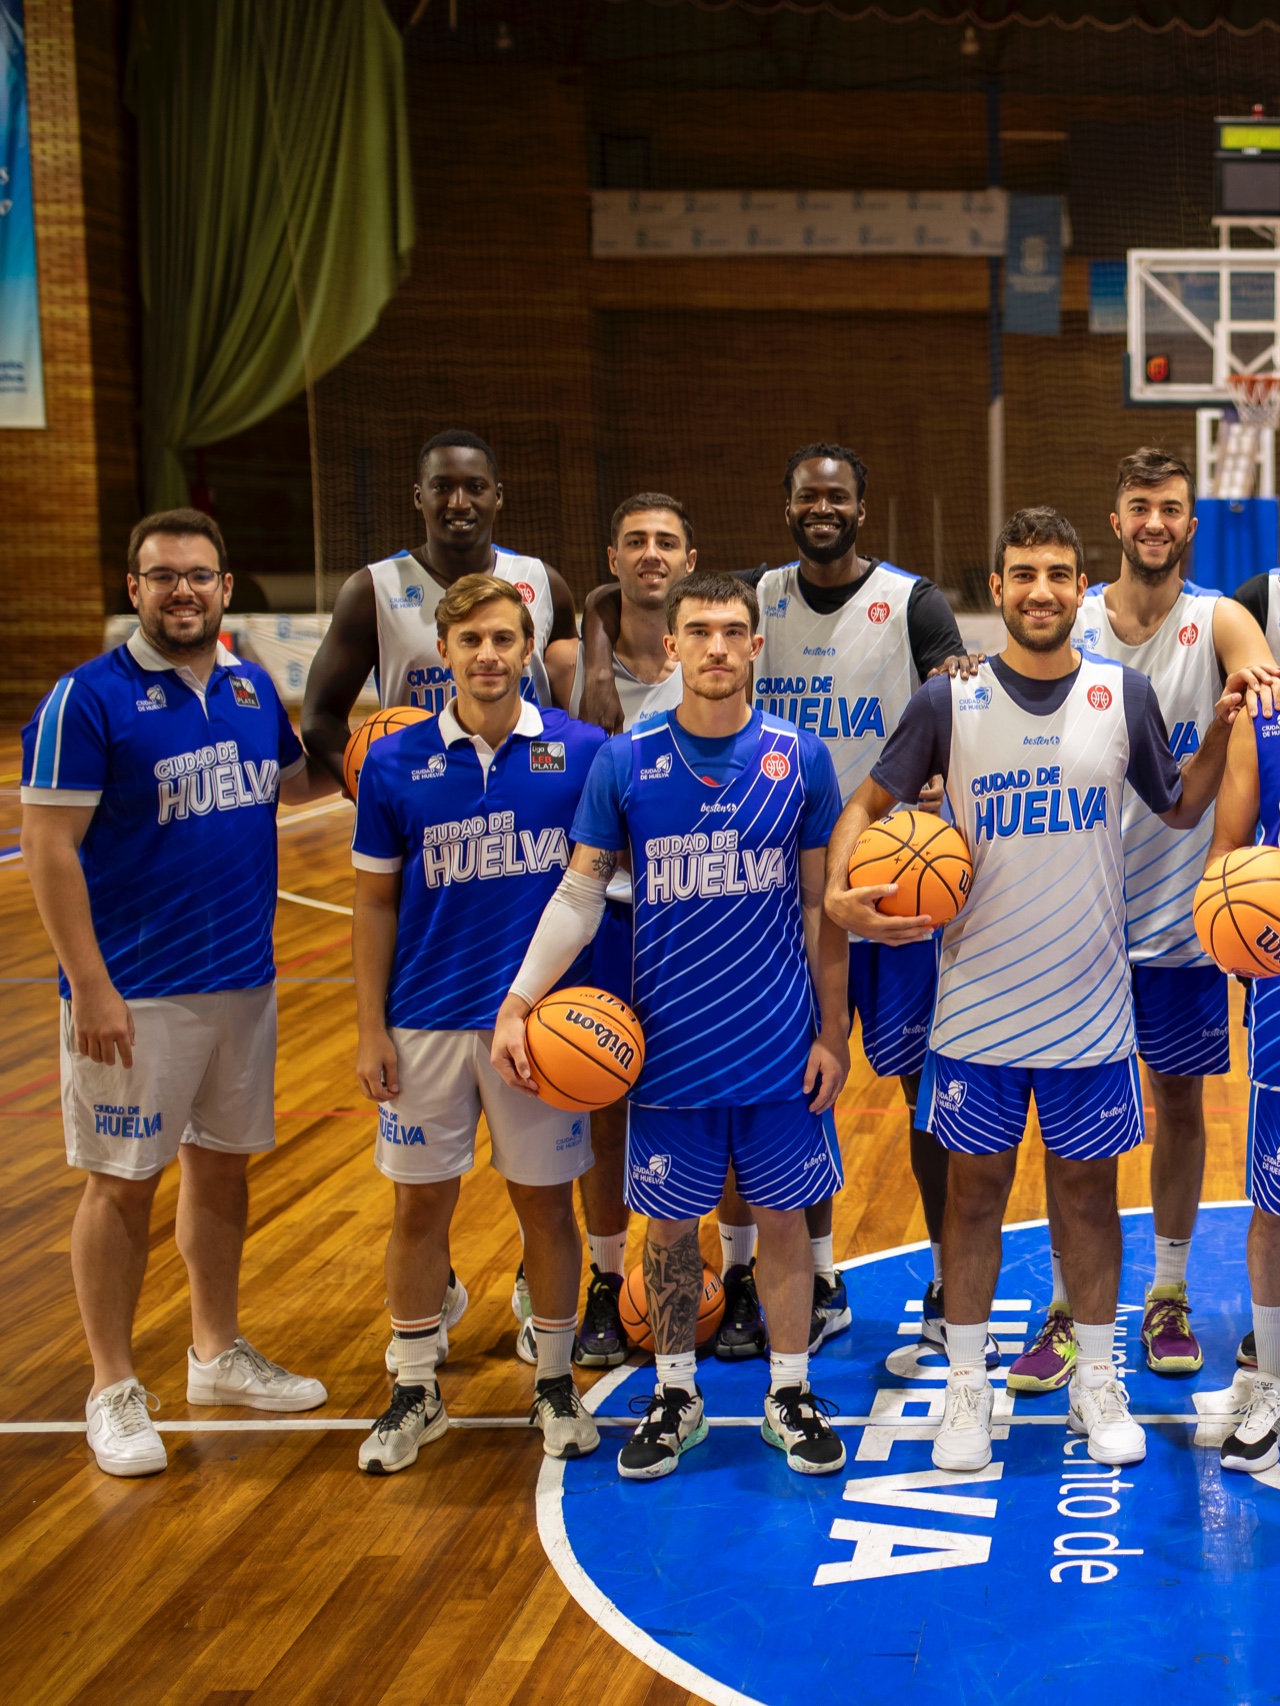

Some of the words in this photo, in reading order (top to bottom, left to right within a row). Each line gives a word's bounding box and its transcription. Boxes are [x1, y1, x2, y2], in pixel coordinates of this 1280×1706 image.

[235, 690, 248, 698] LEB
[755, 675, 807, 695] CIUDAD
[810, 674, 834, 694] DE
[237, 698, 257, 706] PLATA
[1023, 735, 1050, 746] besten
[154, 746, 217, 780] CIUDAD
[216, 740, 239, 763] DE
[532, 755, 552, 763] LEB
[411, 768, 436, 776] CIUDAD
[421, 772, 445, 780] HUELVA
[971, 769, 1032, 797] CIUDAD
[1035, 766, 1061, 786] DE
[975, 787, 1108, 846] HUELVA
[423, 815, 487, 847] CIUDAD
[488, 810, 515, 833] DE
[645, 832, 710, 860] CIUDAD
[711, 829, 739, 850] DE
[423, 827, 571, 889] HUELVA
[646, 847, 787, 906] HUELVA
[565, 1007, 636, 1071] Wilson
[94, 1104, 124, 1115] CIUDAD
[128, 1106, 140, 1115] DE
[95, 1112, 162, 1138] HUELVA
[633, 1165, 655, 1177] CIUDAD
[640, 1174, 665, 1186] HUELVA
[1049, 1531, 1144, 1584] de
